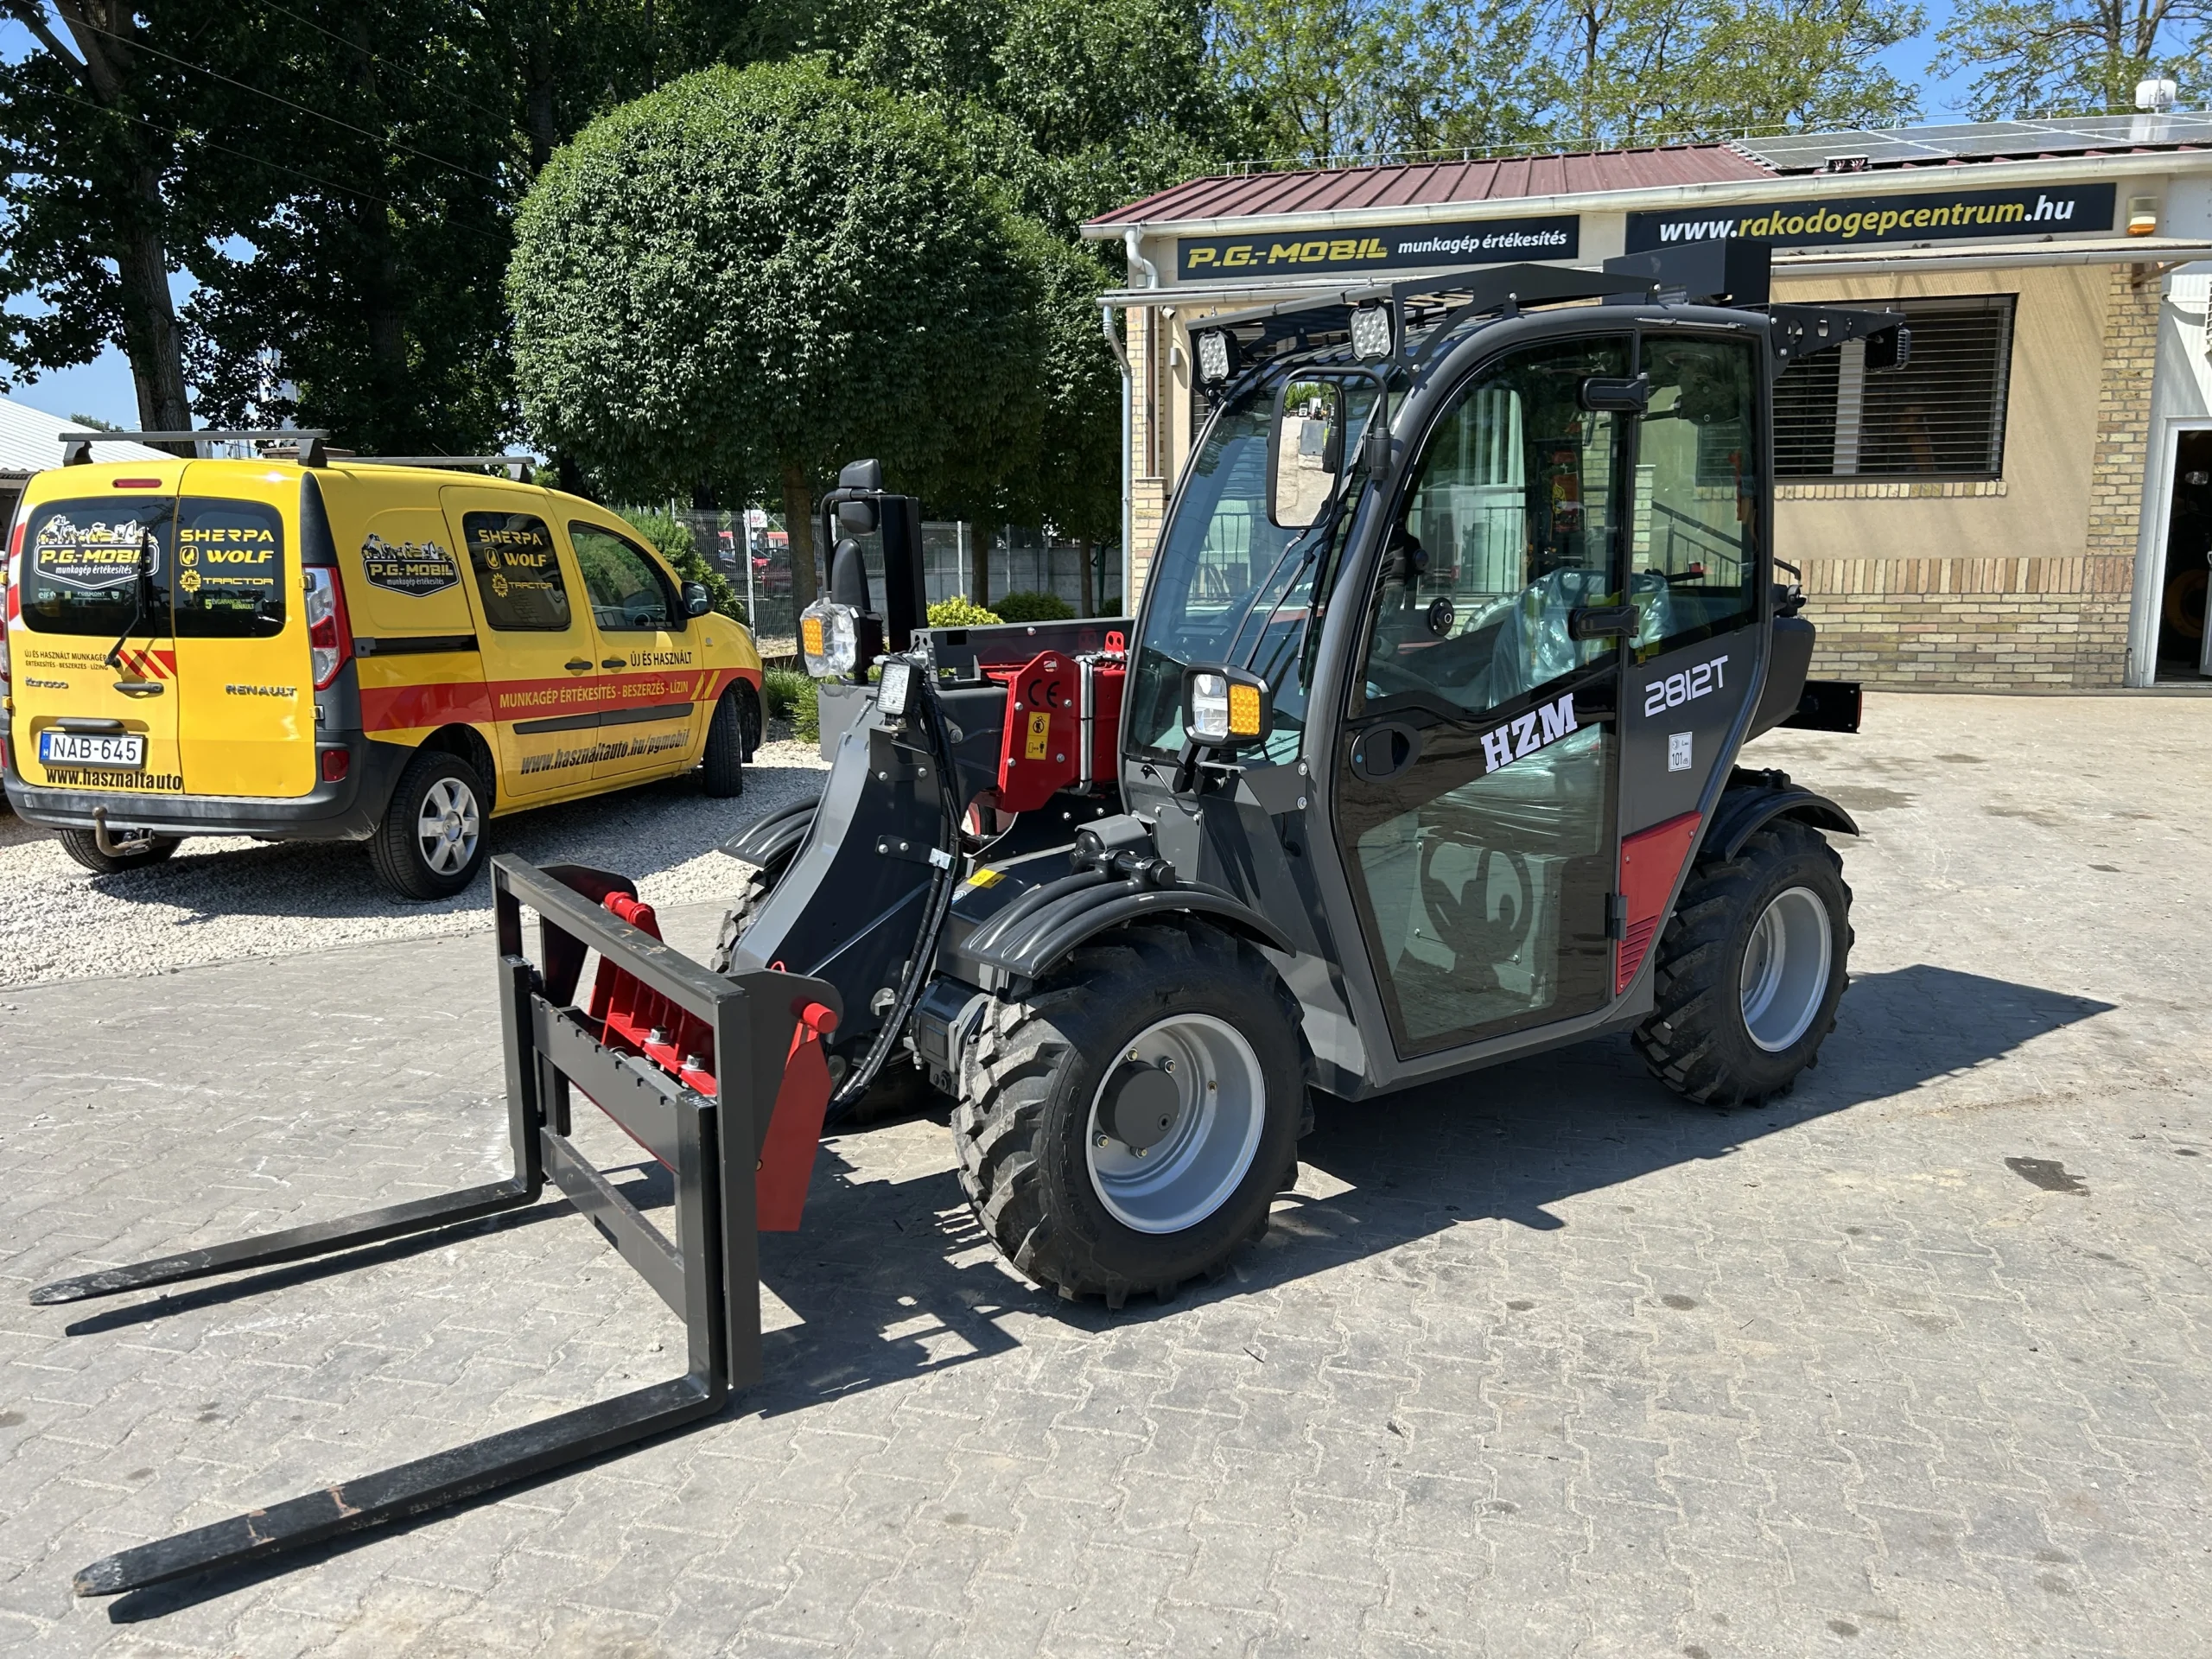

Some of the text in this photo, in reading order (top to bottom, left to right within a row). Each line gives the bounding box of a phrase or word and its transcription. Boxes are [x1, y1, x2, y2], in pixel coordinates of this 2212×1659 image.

[1659, 195, 2075, 241] www.rakodogepcentrum.hu
[1187, 229, 1567, 268] P.G.-MOBIL munkagép értékesítés
[180, 529, 275, 542] SHERPA
[478, 529, 543, 545] SHERPA
[207, 550, 274, 563] WOLF
[504, 553, 547, 567] WOLF
[55, 564, 132, 576] munkagép értékesítés
[370, 564, 454, 576] P.G.-MOBIL
[203, 577, 274, 586] TRACTOR
[386, 577, 415, 588] munkagép
[205, 598, 213, 610] 5
[24, 649, 107, 662] ÚJ ÉS HASZNÁLT MUNKAGÉP
[630, 650, 692, 667] ÚJ ÉS HASZNÁLT
[226, 684, 298, 697] RENAULT
[1644, 655, 1728, 717] 2812T
[499, 690, 558, 709] MUNKAGÉP
[560, 684, 616, 703] ÉRTÉKESÍTÉS
[622, 682, 665, 698] BESZERZÉS
[670, 679, 689, 694] LÍZIN
[1480, 693, 1578, 774] HZM
[54, 737, 137, 761] NAB-645
[520, 728, 690, 775] www.hasznaltauto.hu/pgmobil
[1672, 752, 1682, 766] 101
[47, 768, 182, 791] www.hasznaltauto
